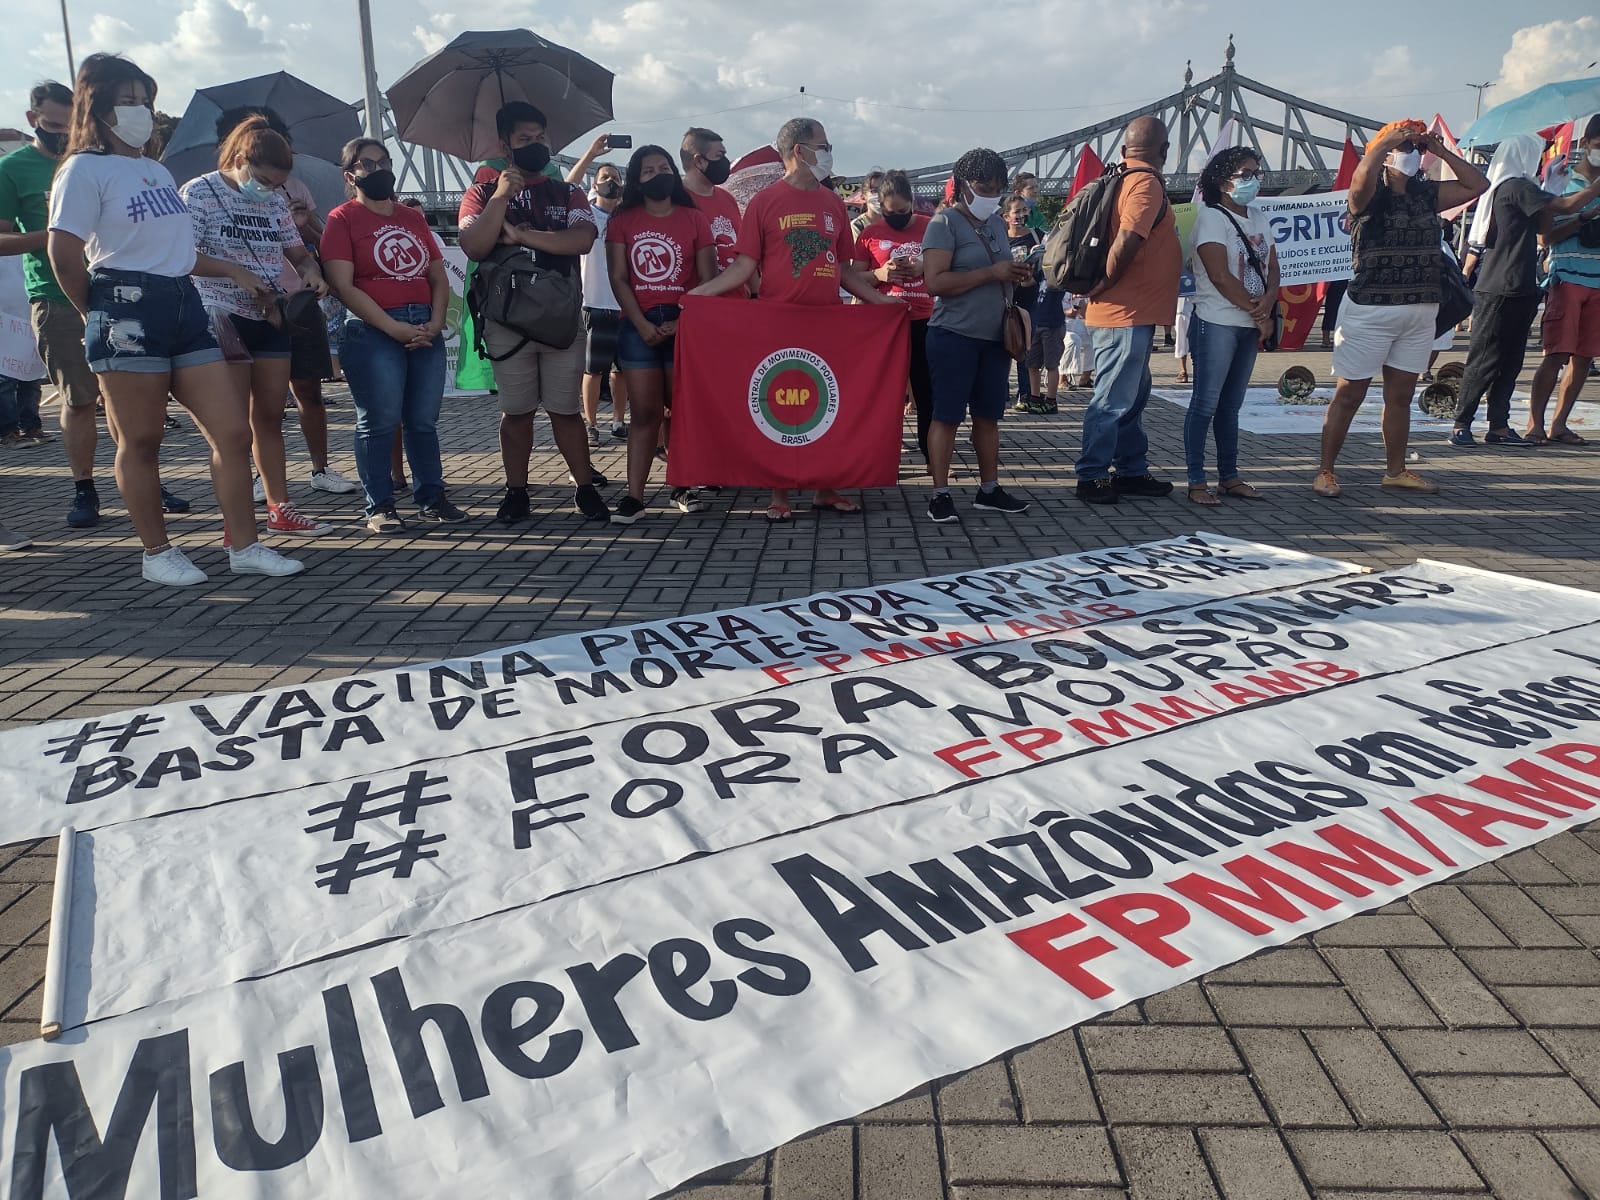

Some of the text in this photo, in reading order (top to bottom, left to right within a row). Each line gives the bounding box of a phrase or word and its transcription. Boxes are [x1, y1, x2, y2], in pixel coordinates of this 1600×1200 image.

[233, 213, 273, 229] UVENTUDE
[1273, 202, 1314, 211] UMBANDA
[1277, 249, 1309, 260] LUÍDOS
[1280, 270, 1292, 279] ÕES
[1302, 268, 1332, 276] MATRIZES
[1288, 260, 1331, 270] PRECONCEITO
[752, 351, 836, 414] CENTRAL DE MOVIMENTOS POPULARES
[775, 388, 810, 405] CMP
[781, 434, 811, 444] BRASIL
[190, 650, 556, 736] VACINA
[581, 615, 764, 666] PARA
[761, 588, 932, 628] TODA
[66, 715, 384, 804] BASTA
[427, 688, 521, 730] DE
[555, 631, 840, 704] MORTES
[849, 613, 939, 642] NO
[506, 677, 936, 803] FORA
[952, 575, 1454, 689] BOLSONARO
[512, 734, 897, 849] FORA
[949, 629, 1349, 737] MOURÃO
[935, 661, 1360, 778] FPMM/AMB
[12, 917, 811, 1200] Mulheres
[1315, 731, 1478, 787] em
